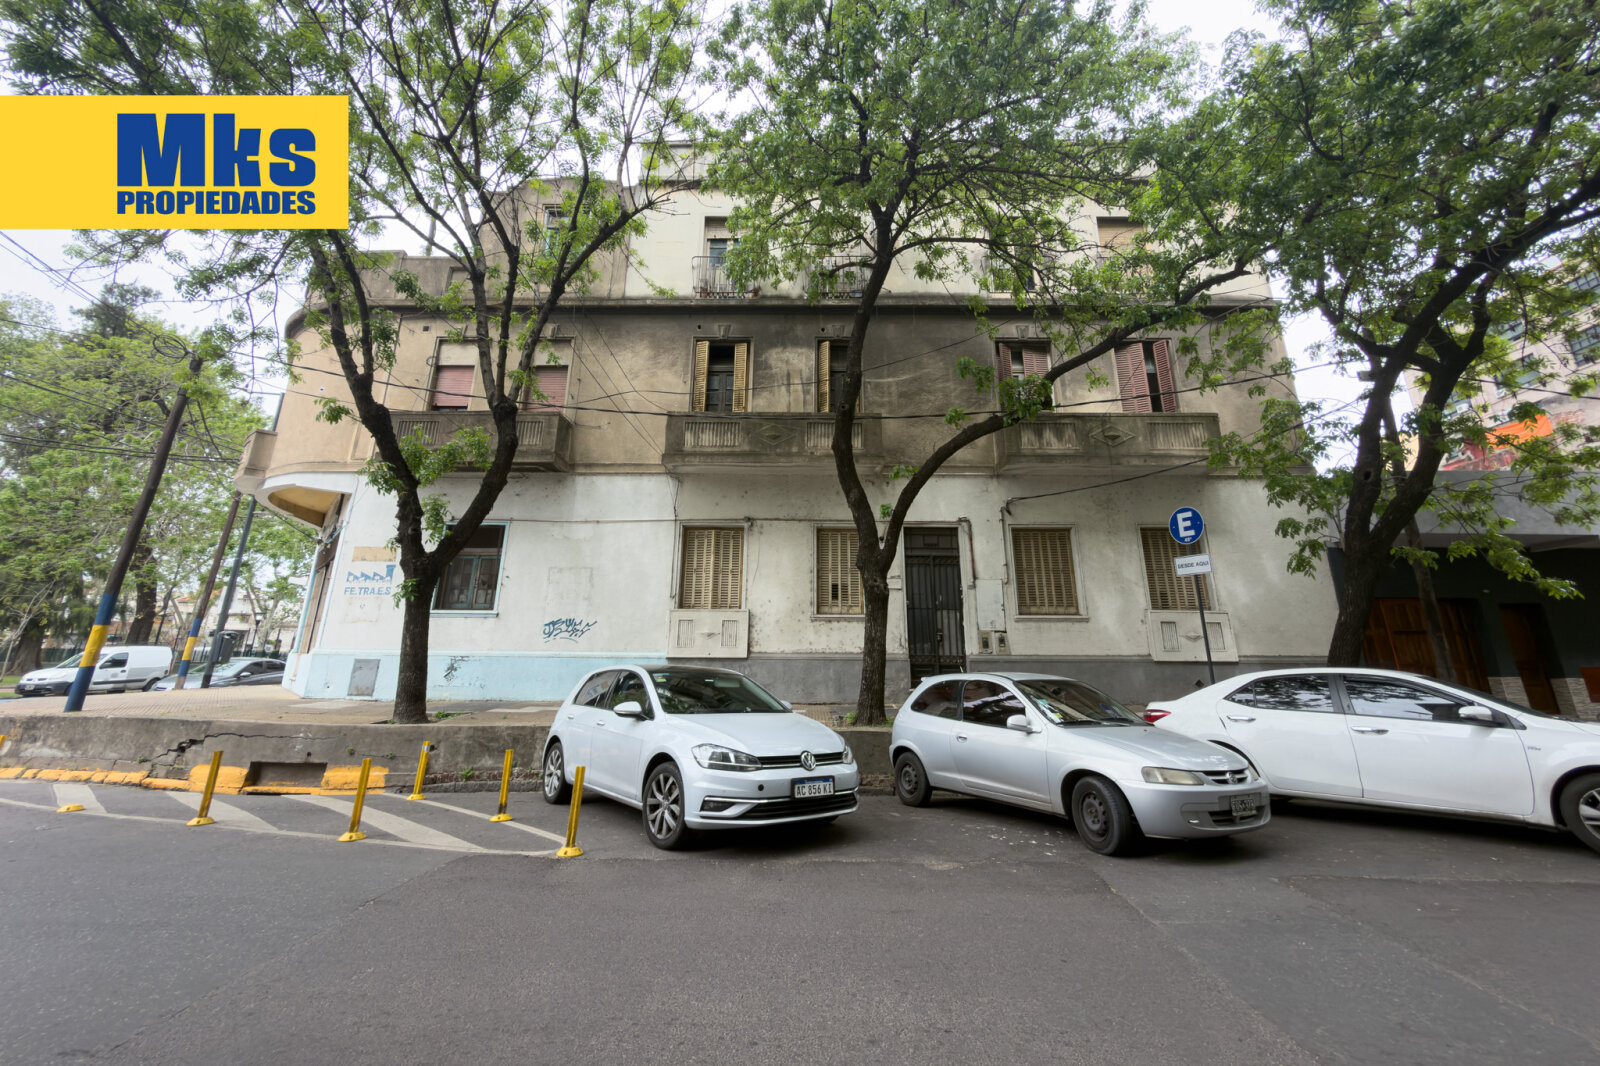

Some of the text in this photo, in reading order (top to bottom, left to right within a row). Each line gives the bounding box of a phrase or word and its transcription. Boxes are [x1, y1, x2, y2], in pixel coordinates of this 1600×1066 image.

[1176, 511, 1195, 538] E
[796, 785, 806, 797] AC
[808, 784, 821, 796] 856
